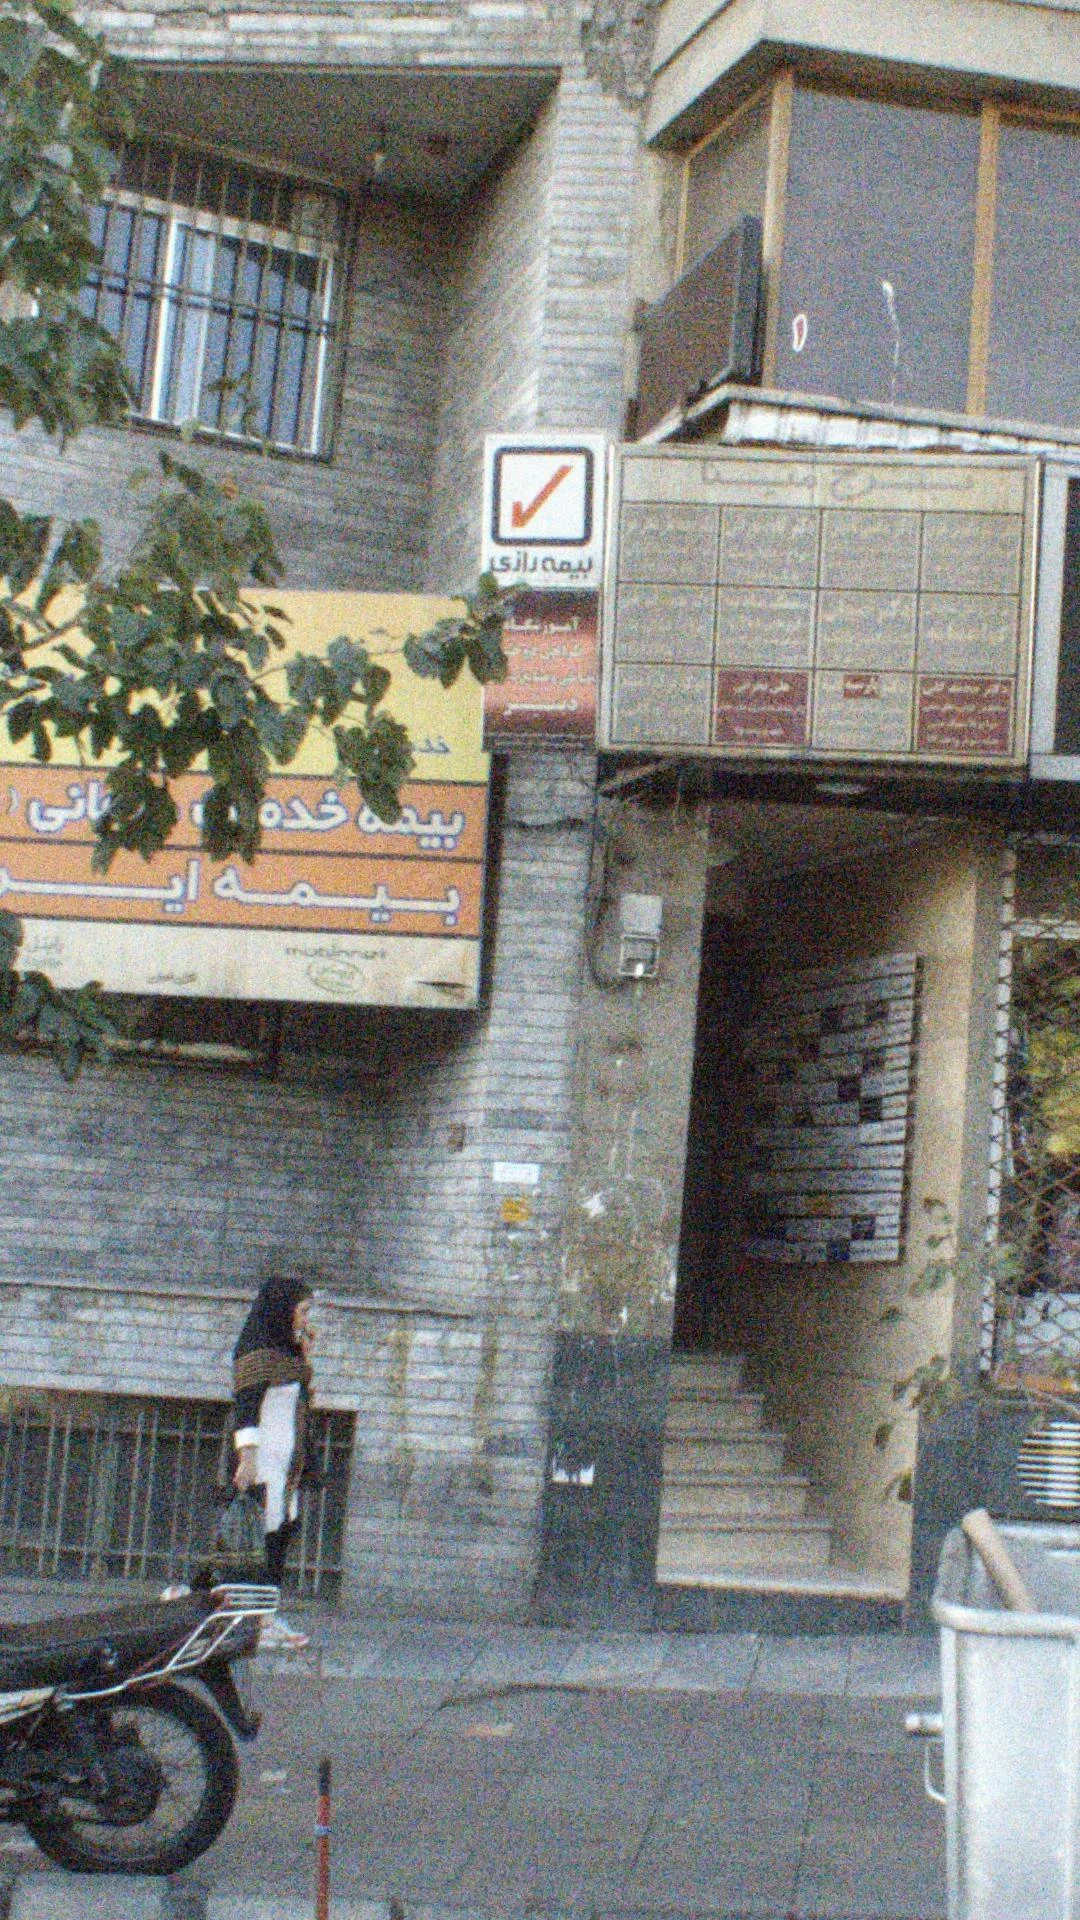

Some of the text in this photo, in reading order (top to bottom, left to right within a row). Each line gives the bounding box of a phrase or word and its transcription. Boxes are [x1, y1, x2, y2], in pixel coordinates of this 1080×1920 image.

[489, 551, 593, 580] بیمه رازی
[357, 803, 465, 850] بیمه
[212, 864, 461, 927] بیمه
